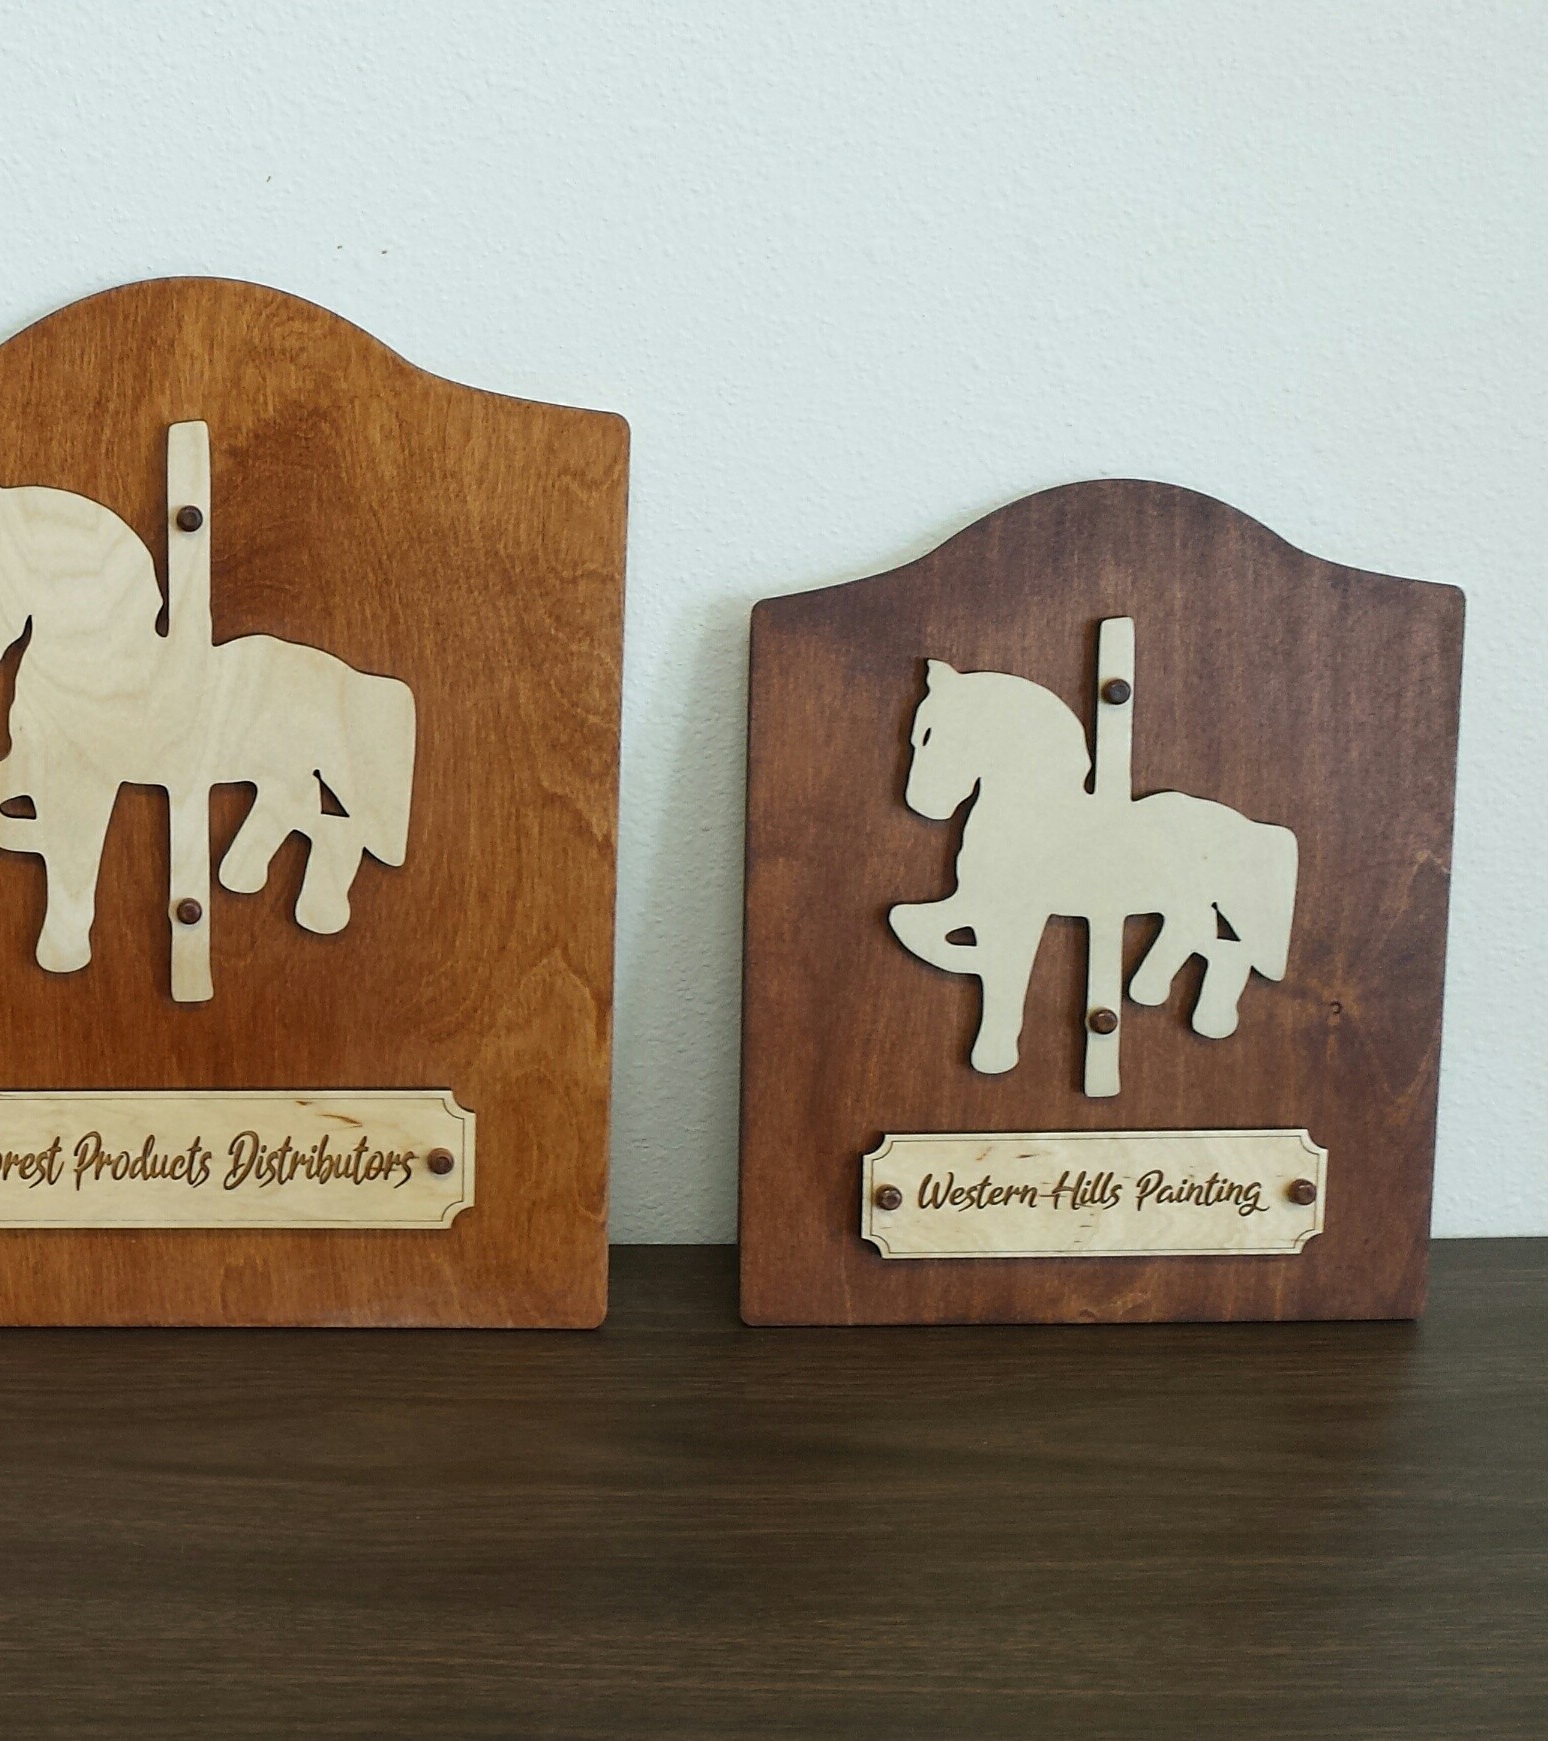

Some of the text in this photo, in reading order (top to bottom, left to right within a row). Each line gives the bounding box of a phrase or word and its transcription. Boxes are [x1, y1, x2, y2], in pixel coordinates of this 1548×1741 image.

[72, 1130, 213, 1191] Products
[223, 1130, 416, 1191] Distributors
[1136, 1169, 1270, 1217] Painting
